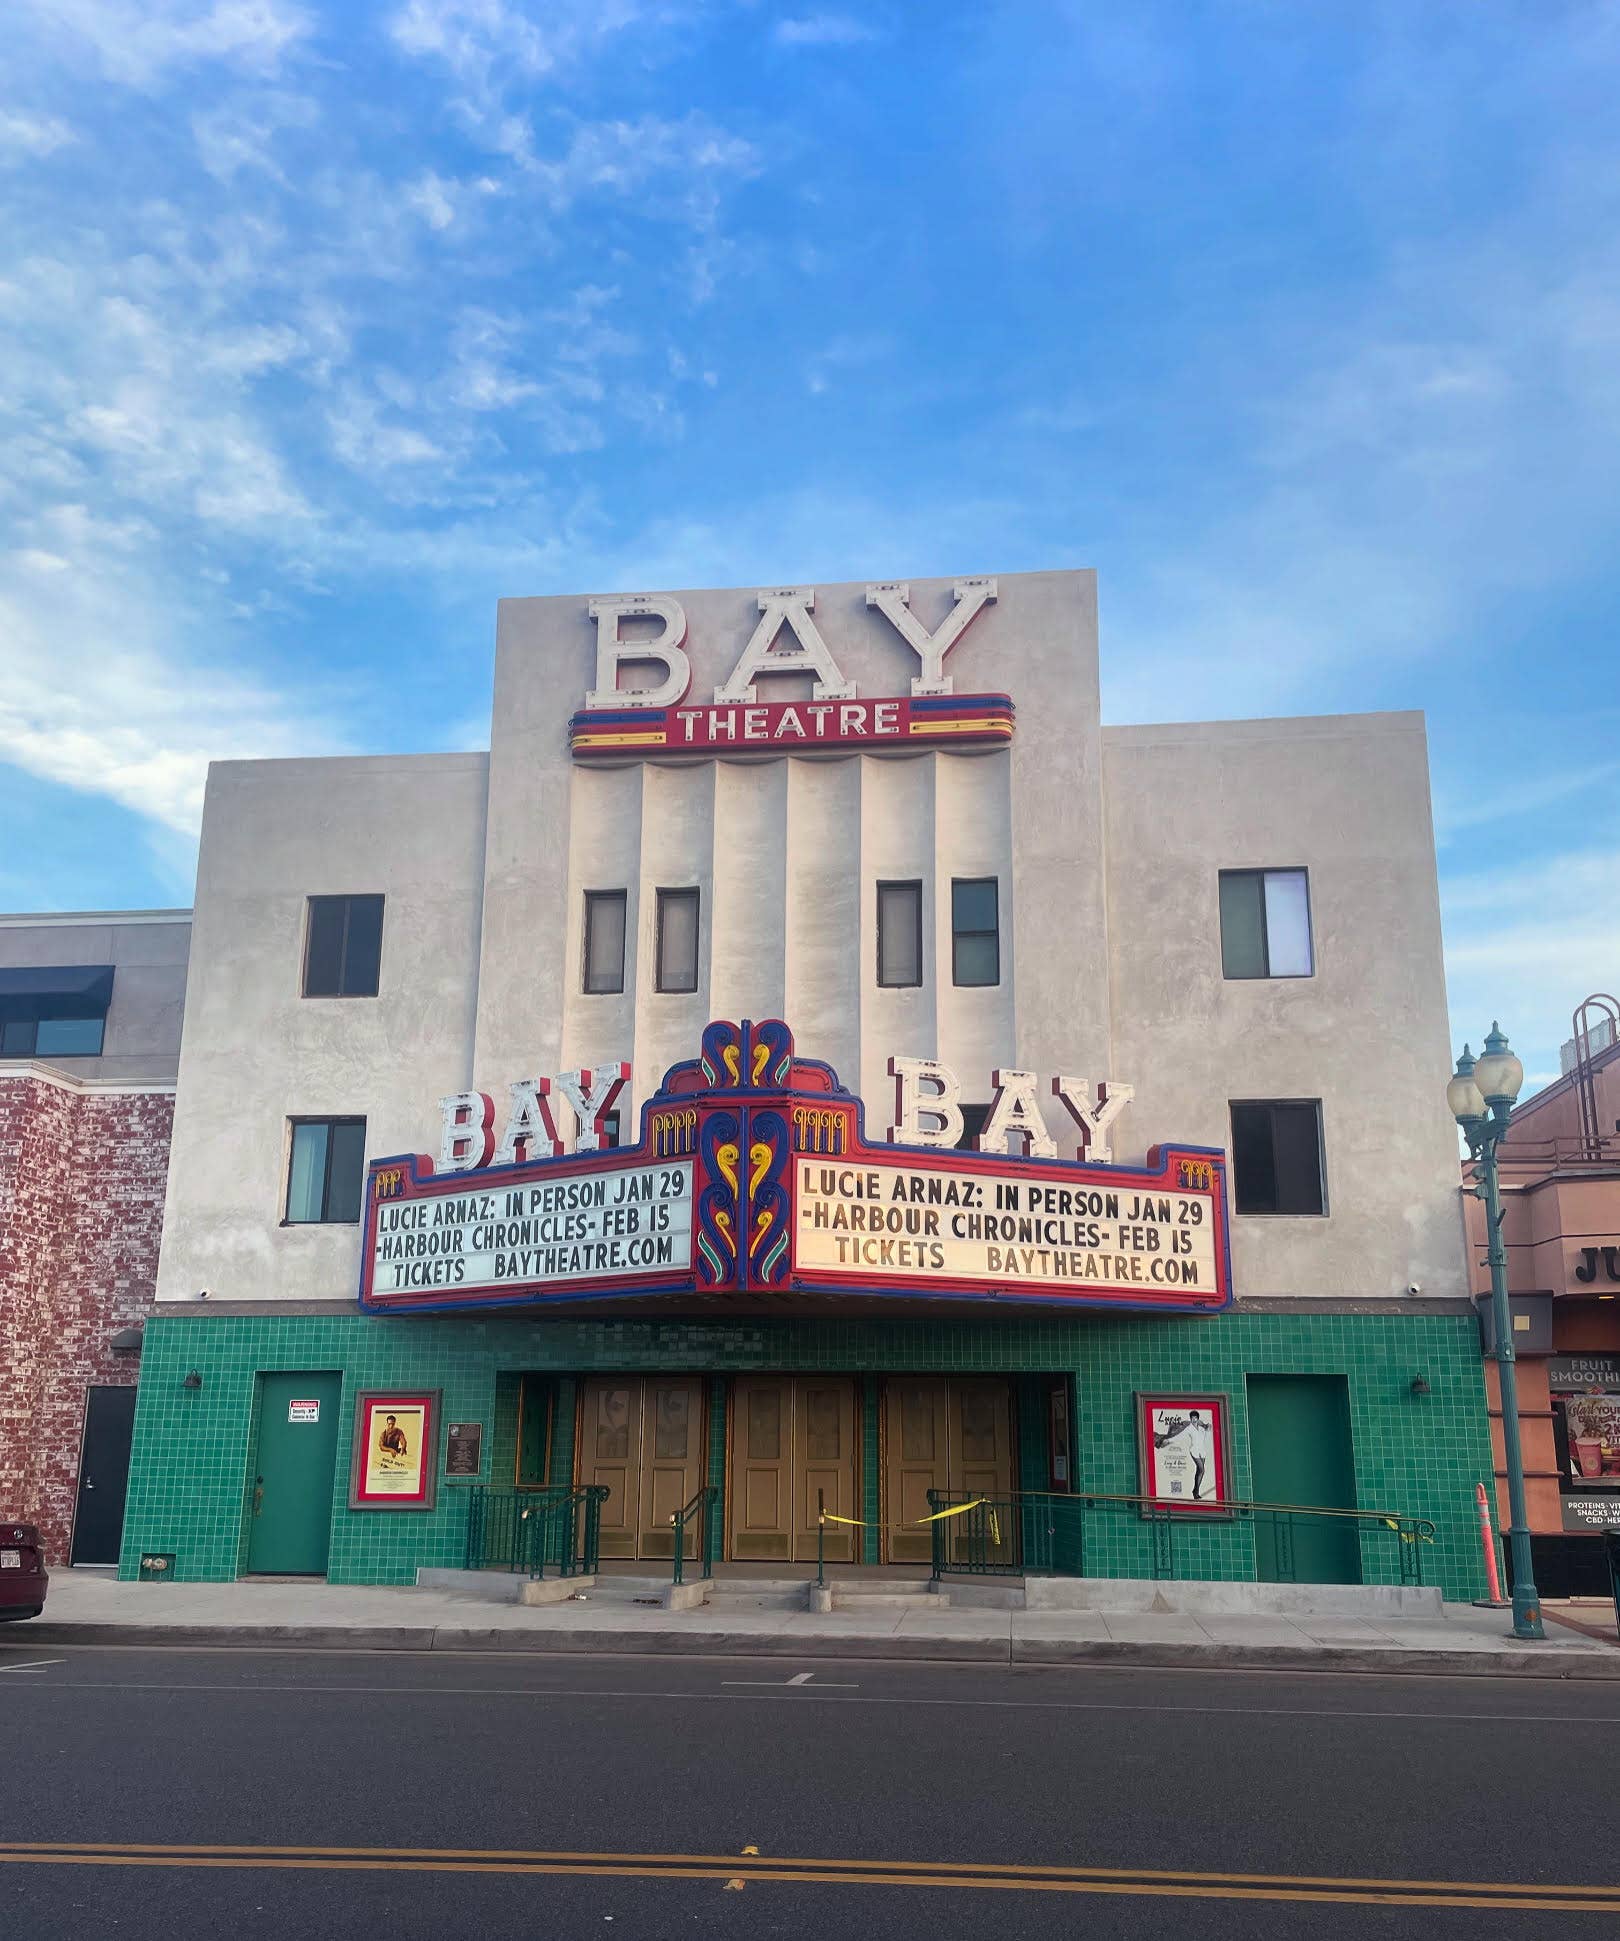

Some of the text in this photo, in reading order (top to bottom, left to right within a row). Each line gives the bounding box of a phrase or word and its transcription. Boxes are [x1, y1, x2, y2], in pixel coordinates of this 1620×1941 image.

[585, 576, 998, 710] BAY
[676, 703, 899, 742] THEATRE
[435, 1061, 631, 1175] BAY
[887, 1055, 1135, 1165] BAY
[379, 1169, 684, 1232] LUCIE ARNAZ: IN PERSON JAN 29
[803, 1167, 1203, 1226] LUCIE ARNAZ: IN PERSON JAN 29
[602, 1209, 640, 1238] FEB
[649, 1204, 670, 1232] 15
[1119, 1225, 1160, 1253] FEB
[1172, 1229, 1193, 1254] 15
[394, 1236, 673, 1288] TICKETS BAYTHEATRE.COM
[834, 1236, 1199, 1285] TICKETS BAYTHEATRE.COM
[1575, 1246, 1620, 1282] JU
[1571, 1359, 1613, 1371] FRUIT
[1568, 1501, 1606, 1510] PROTEINS
[1577, 1509, 1608, 1517] SNACKS
[1585, 1516, 1604, 1524] CBD
